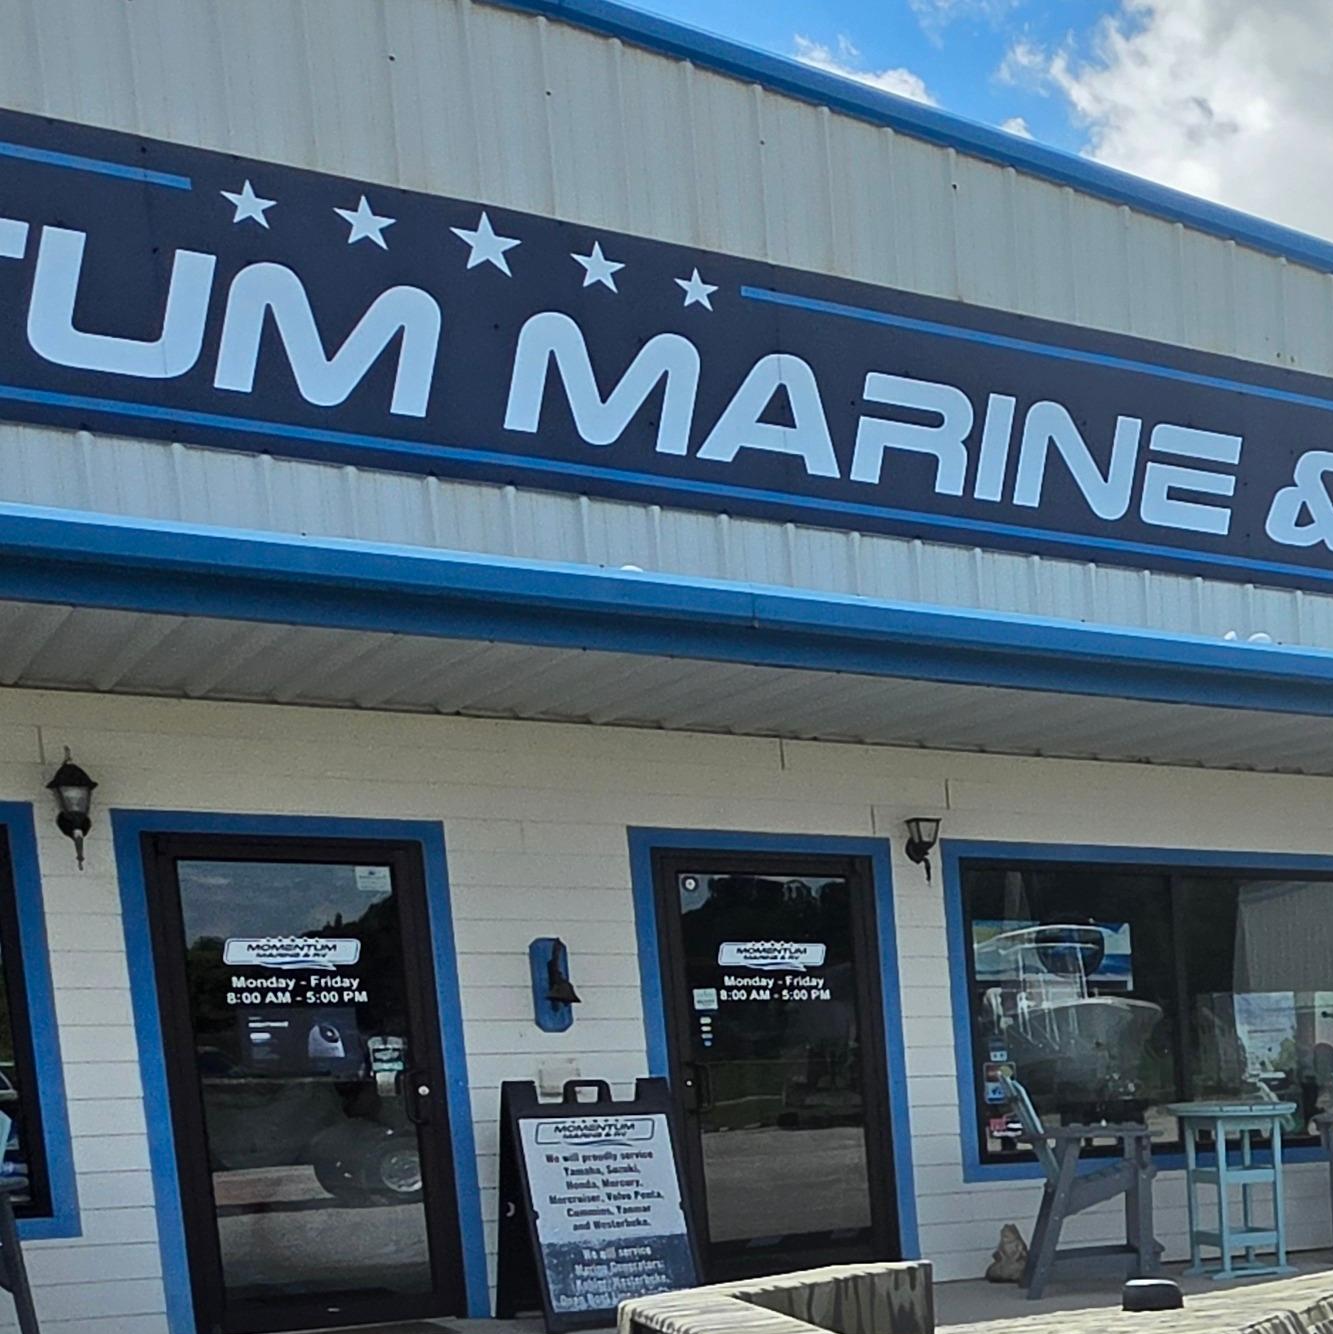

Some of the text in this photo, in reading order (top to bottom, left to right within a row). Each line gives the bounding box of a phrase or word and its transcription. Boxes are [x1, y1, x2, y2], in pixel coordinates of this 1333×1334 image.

[503, 311, 1243, 536] MARINE
[247, 943, 337, 952] MOMENTUM
[736, 947, 807, 955] MOMENTUM
[231, 976, 296, 991] Monday
[310, 975, 360, 990] Friday
[724, 976, 775, 989] Monday
[785, 975, 825, 988] Friday
[226, 992, 261, 1004] 8:00
[265, 992, 292, 1003] AM
[306, 991, 339, 1003] 5:00
[343, 991, 368, 1002] PM
[720, 989, 747, 1000] 8:00
[750, 989, 771, 1000] AM
[782, 989, 808, 1000] 5:00
[811, 989, 831, 1000] PM
[554, 1123, 635, 1133] MOMENTUM
[562, 1152, 579, 1163] will
[582, 1151, 617, 1164] proudly
[620, 1150, 653, 1160] service
[573, 1220, 590, 1231] and
[618, 1246, 651, 1258] service
